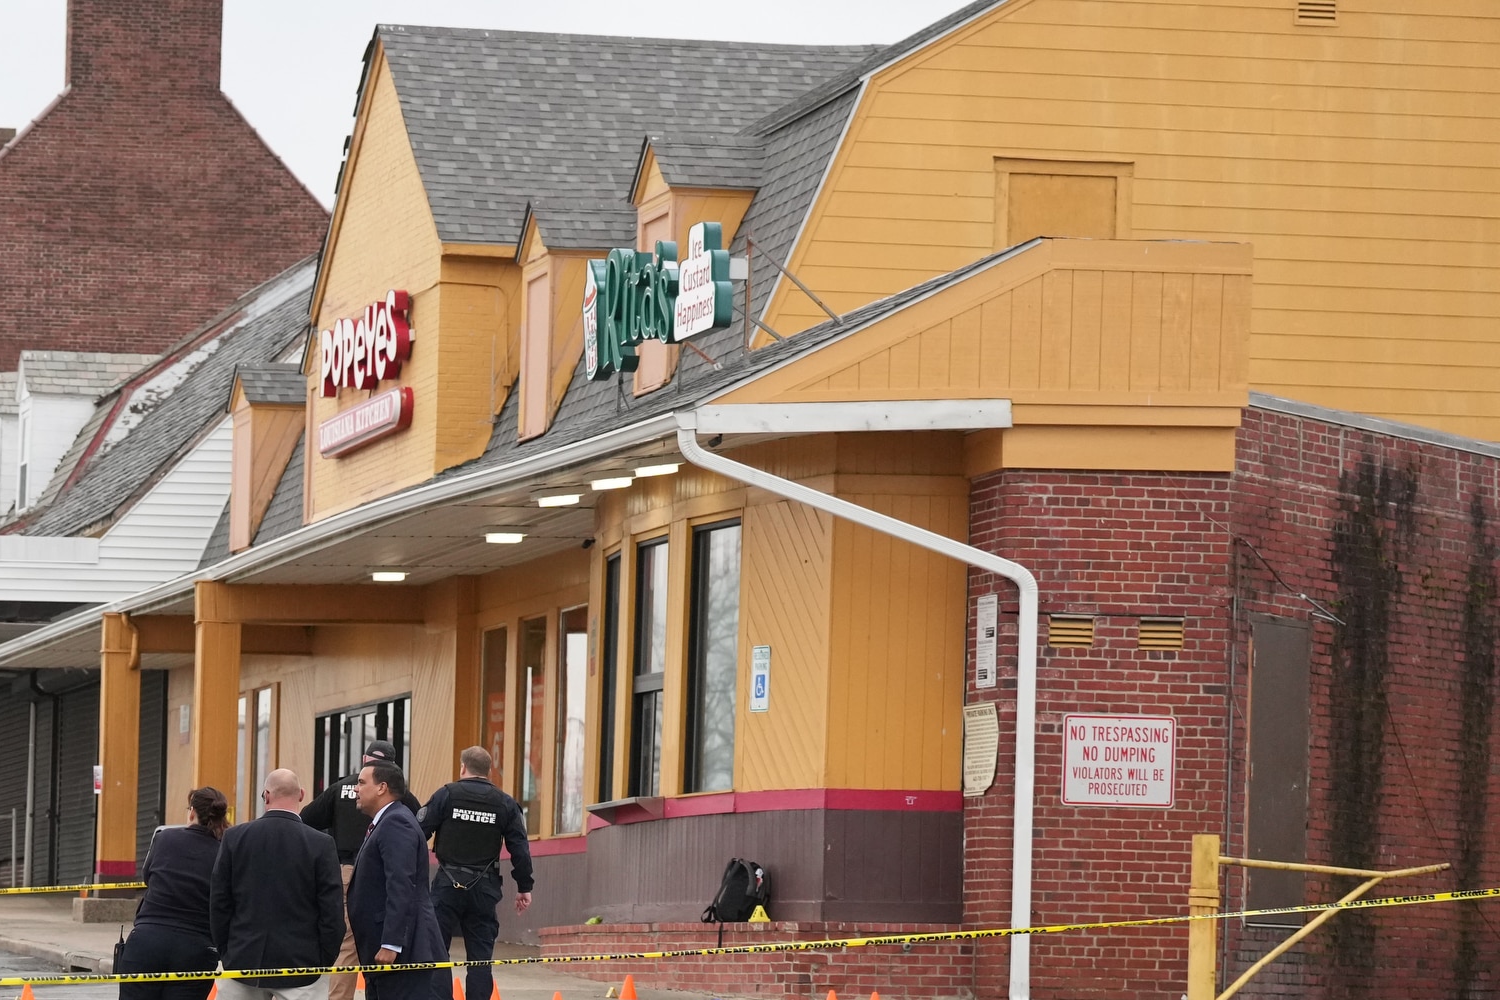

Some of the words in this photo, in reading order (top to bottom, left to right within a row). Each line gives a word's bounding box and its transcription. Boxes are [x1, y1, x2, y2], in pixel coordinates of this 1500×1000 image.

[692, 240, 702, 261] Ice
[683, 265, 710, 292] Custard
[603, 240, 671, 372] Rita's
[677, 296, 713, 332] Happiness
[356, 397, 391, 432] KITCHEN
[1070, 725, 1086, 741] NO
[1092, 726, 1169, 743] TRESPASSING
[1083, 746, 1098, 761] NO
[1104, 746, 1156, 763] DUMPING
[1072, 766, 1123, 780] VIOLATORS
[1127, 768, 1148, 781] WILL
[1153, 769, 1165, 781] BE
[1088, 782, 1148, 796] PROSECUTED
[452, 812, 496, 824] POLICE
[453, 808, 497, 818] BALTIMORE
